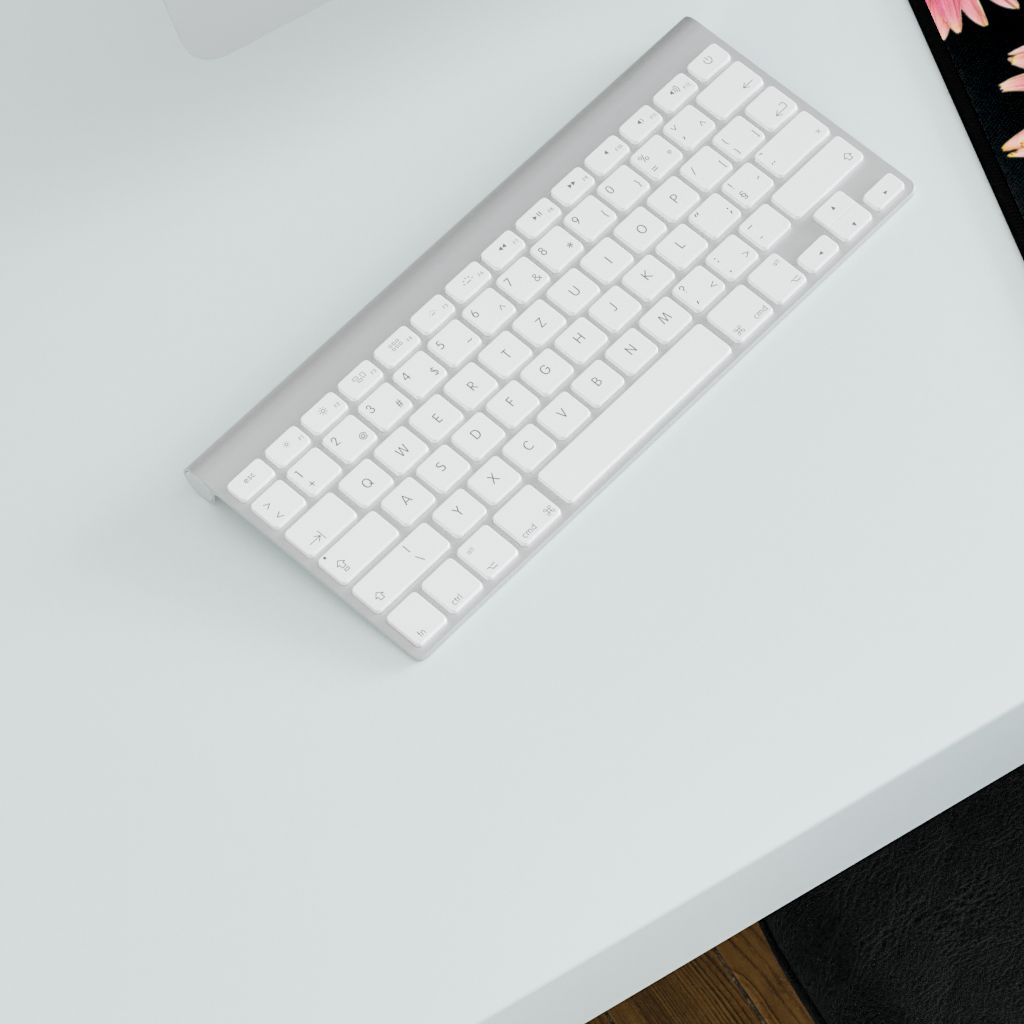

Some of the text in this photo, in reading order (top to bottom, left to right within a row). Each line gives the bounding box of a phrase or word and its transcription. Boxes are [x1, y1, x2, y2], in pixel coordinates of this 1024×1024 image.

[604, 185, 616, 195] 0
[668, 193, 679, 204] P
[570, 216, 582, 225] 9
[635, 224, 648, 234] O
[674, 241, 687, 250] L
[537, 247, 549, 257] 8
[640, 270, 653, 281] K
[502, 277, 514, 288] 7
[567, 285, 582, 297] U
[608, 301, 619, 312] J
[470, 309, 481, 320] 6
[752, 304, 770, 321] cmd
[534, 316, 548, 329] Z
[657, 311, 673, 326] M
[571, 331, 587, 345] H
[434, 340, 446, 351] 5
[623, 343, 638, 356] N
[499, 348, 512, 359] T
[539, 364, 553, 375] G
[400, 371, 412, 383] 4
[590, 376, 603, 387] B
[465, 381, 479, 392] R
[504, 396, 515, 408] F
[365, 403, 377, 415] 3
[555, 407, 568, 418] V
[431, 412, 444, 424] E
[469, 428, 483, 441] D
[329, 435, 342, 448] 2
[520, 440, 535, 451] C
[393, 443, 410, 457] W
[435, 461, 447, 472] S
[293, 469, 305, 479] 1
[486, 472, 501, 486] X
[360, 477, 375, 489] Q
[401, 495, 414, 507] A
[450, 505, 464, 516] Y
[521, 523, 539, 539] cmd
[450, 592, 464, 607] ctrl
[416, 628, 428, 639] fn
